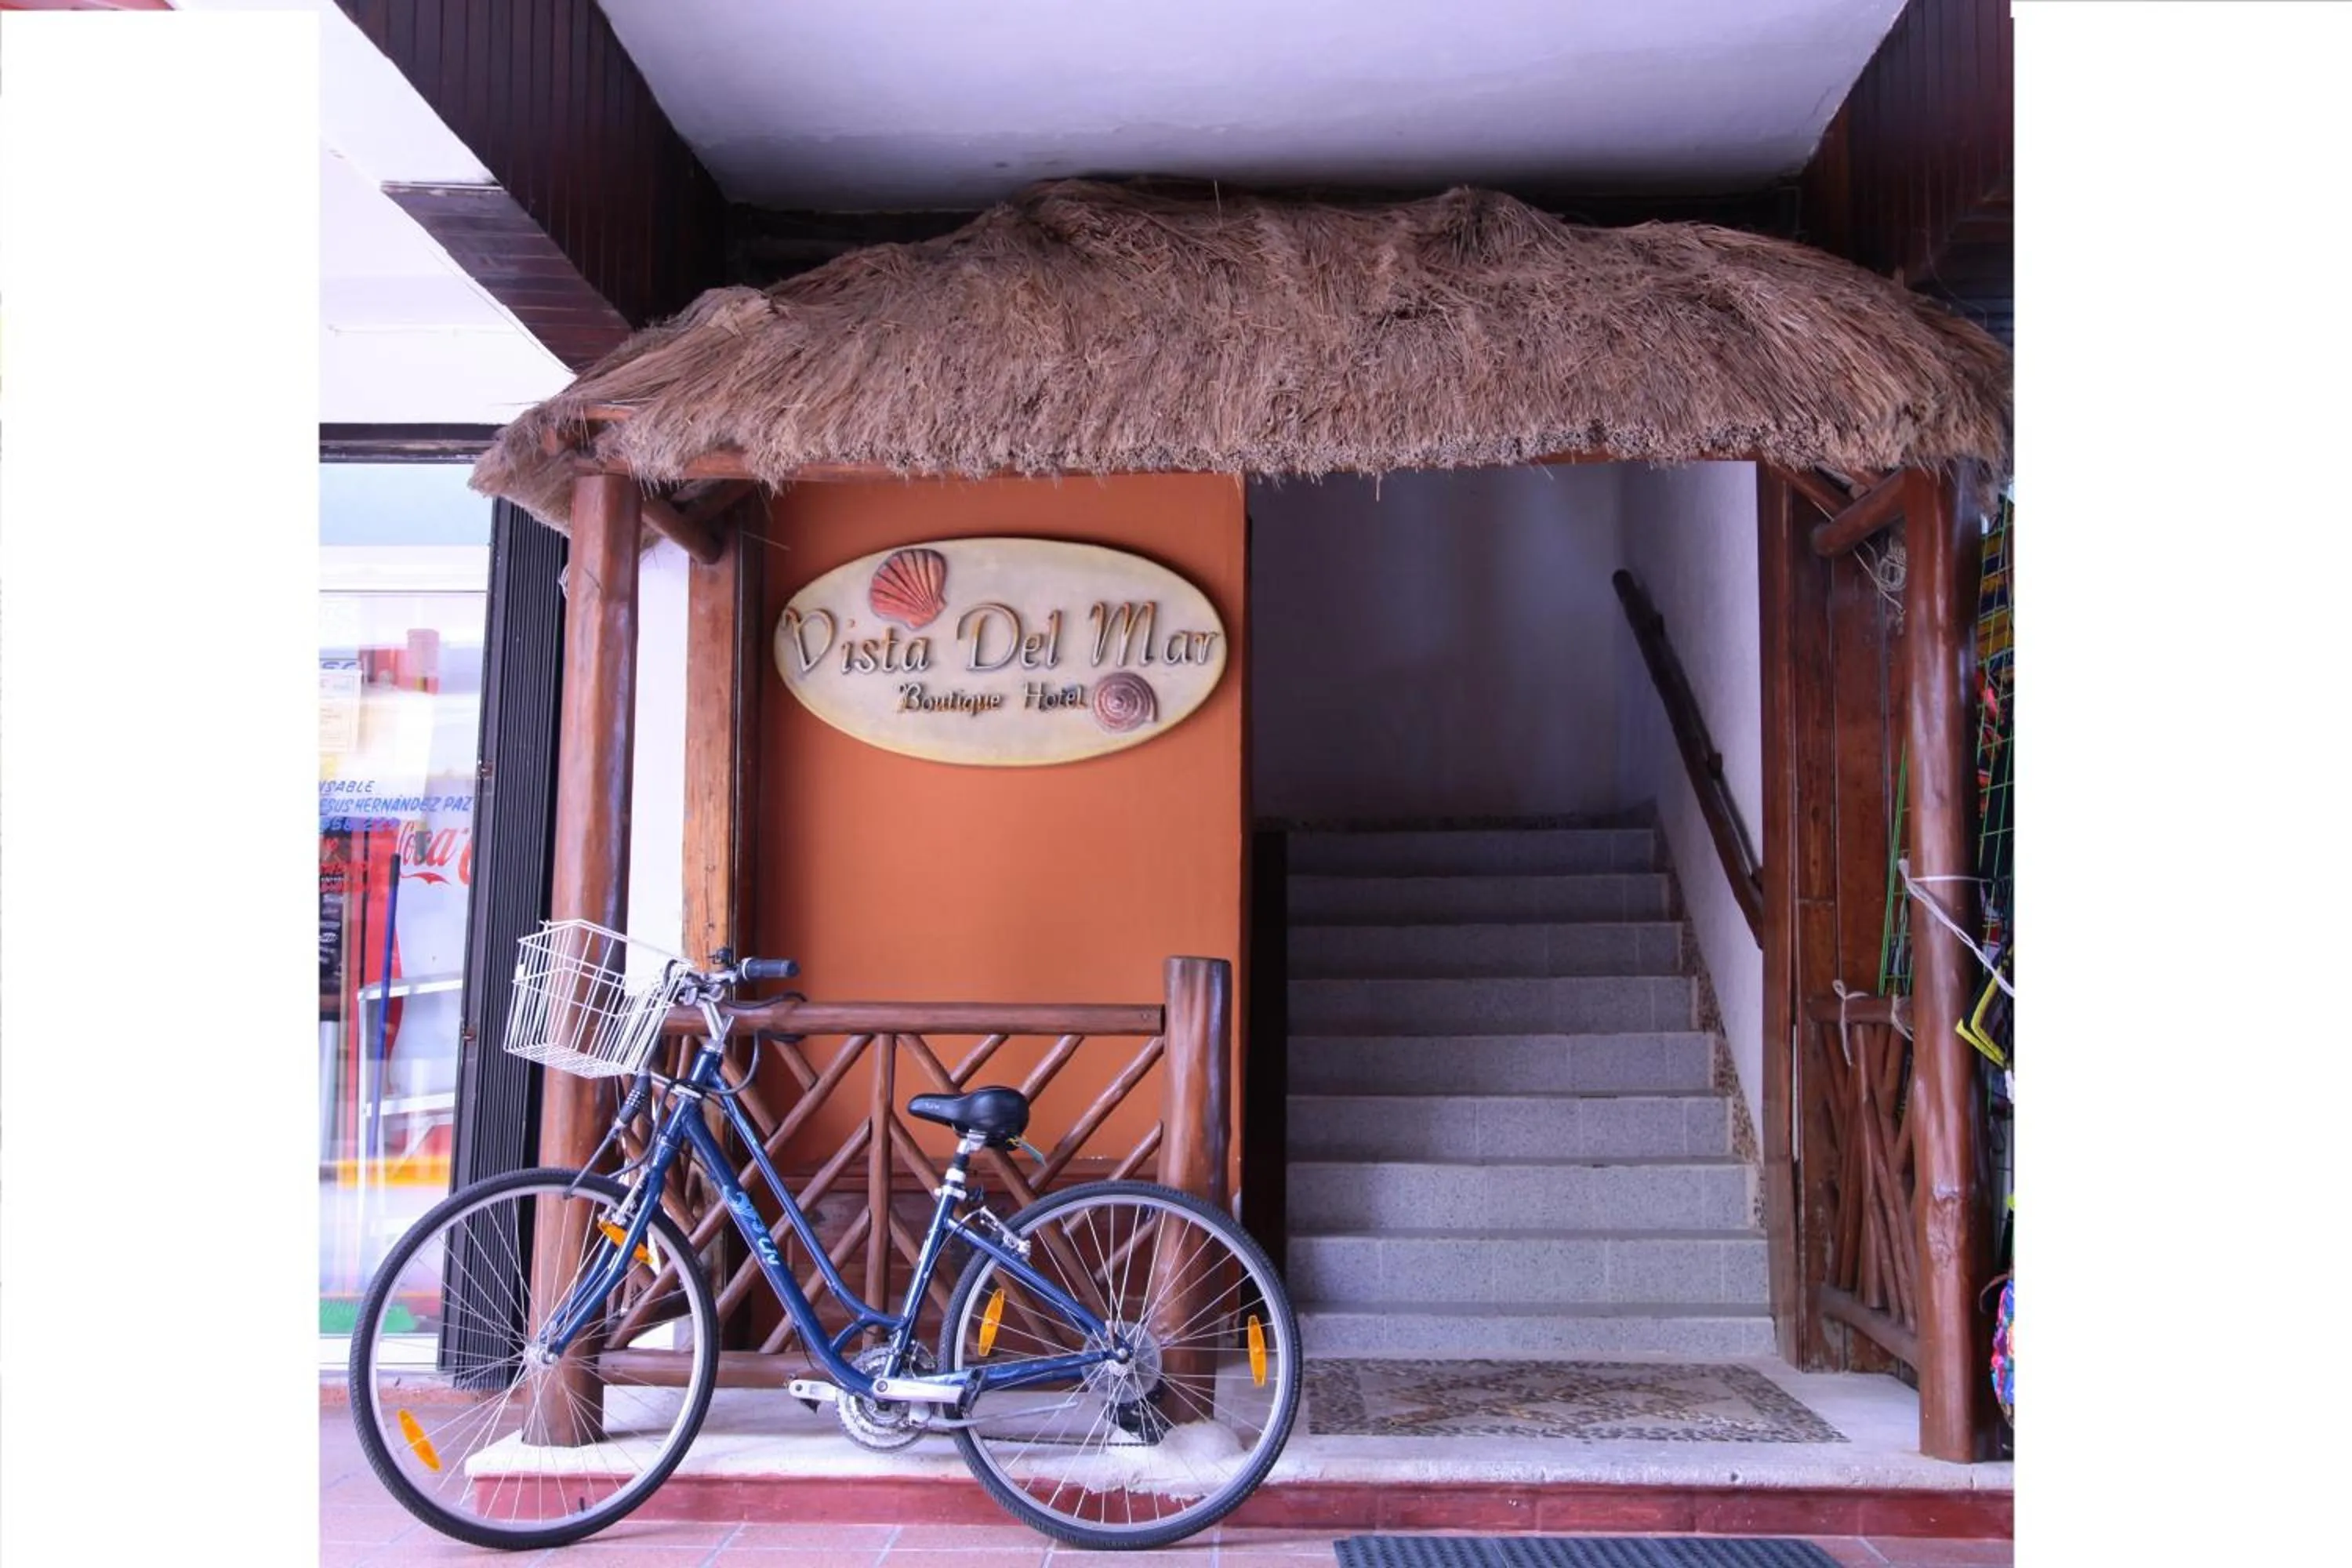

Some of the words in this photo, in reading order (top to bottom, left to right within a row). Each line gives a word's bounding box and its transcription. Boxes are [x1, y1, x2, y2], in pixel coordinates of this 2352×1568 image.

[784, 606, 935, 675] Vista
[956, 601, 1061, 673] Del
[1089, 601, 1221, 669] Mar
[898, 681, 1004, 717] Boutique
[1024, 681, 1087, 711] Hotel
[442, 795, 474, 811] PAZ
